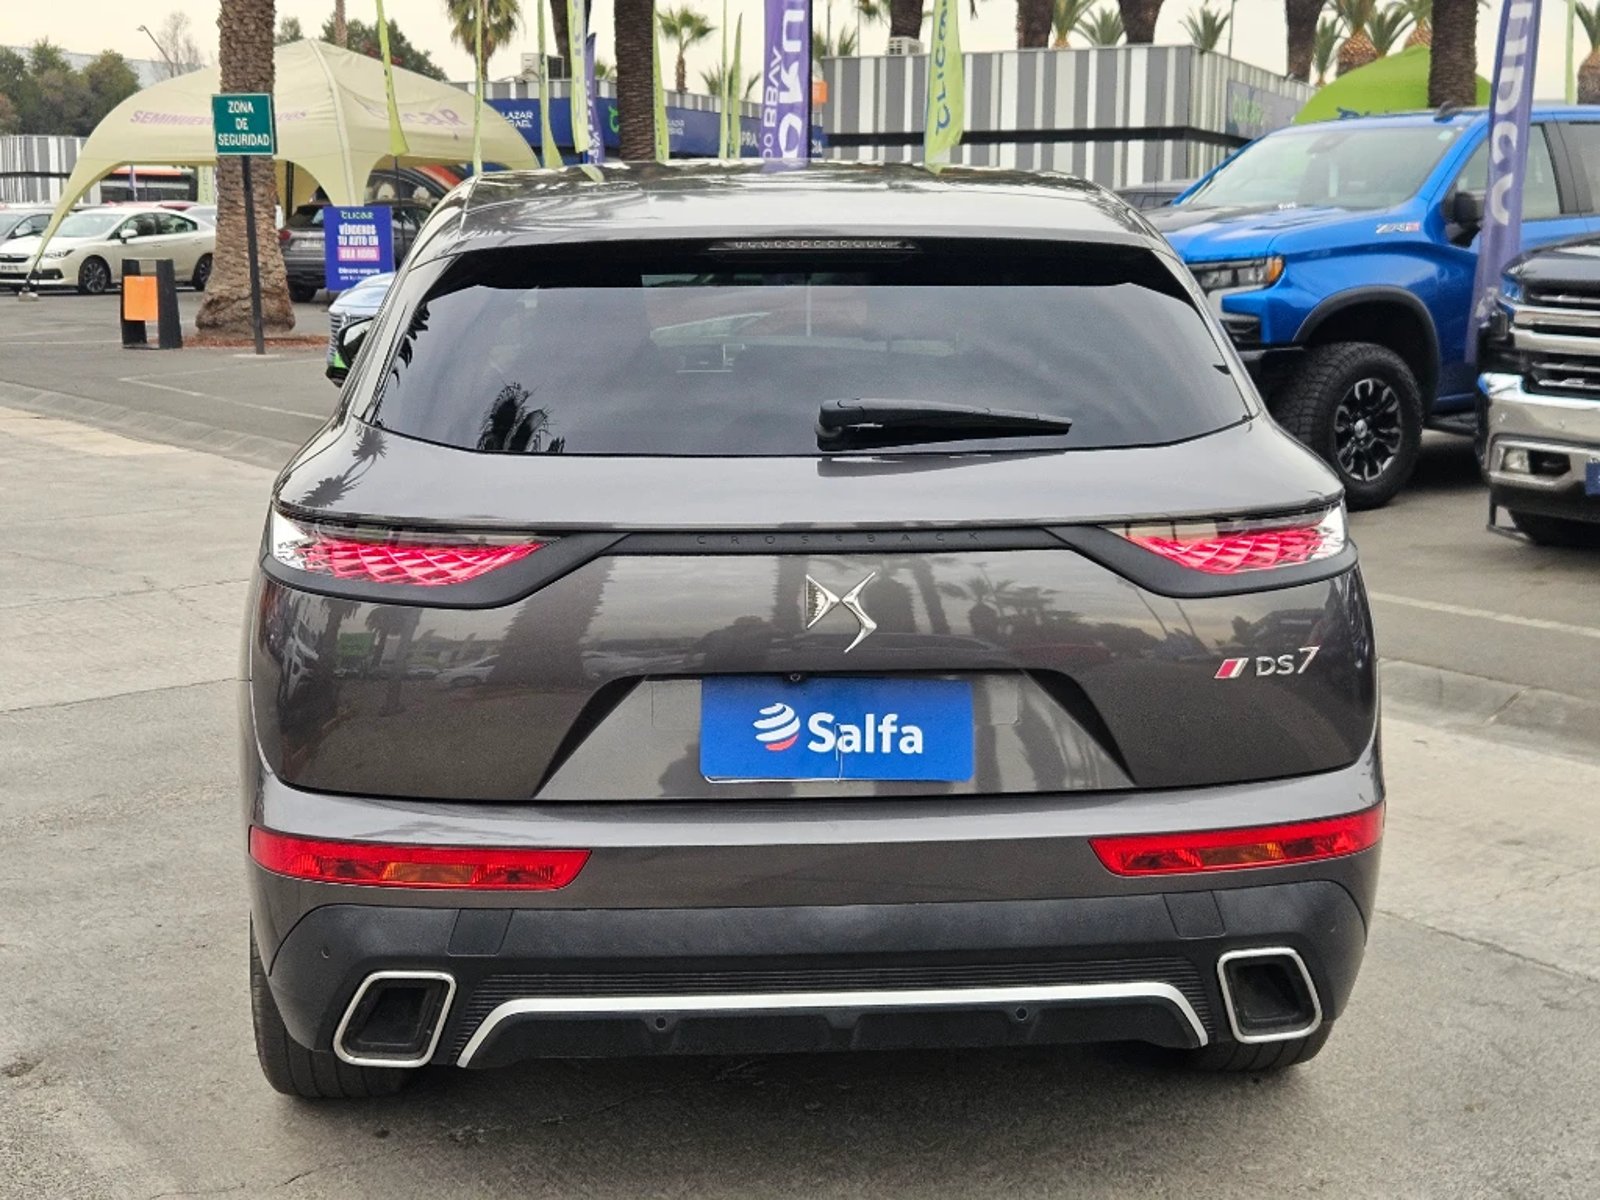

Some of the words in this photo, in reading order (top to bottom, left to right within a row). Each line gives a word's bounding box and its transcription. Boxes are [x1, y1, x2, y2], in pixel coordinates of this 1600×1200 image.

[227, 101, 254, 114] ZONA
[234, 117, 249, 130] DE
[218, 133, 270, 146] SEGURIDAD
[695, 531, 980, 546] CROSSBACK
[807, 711, 924, 755] Salfa
